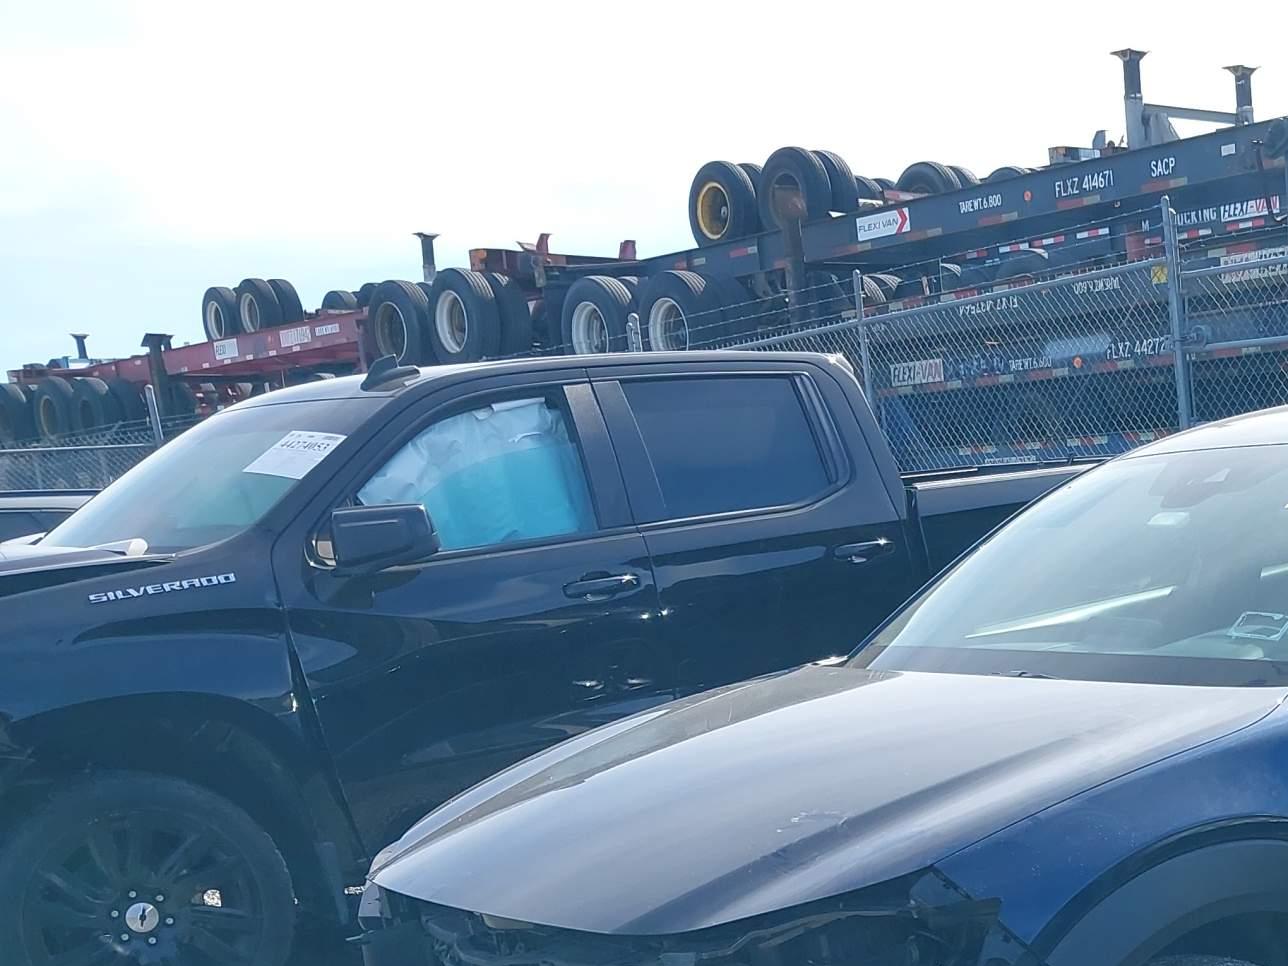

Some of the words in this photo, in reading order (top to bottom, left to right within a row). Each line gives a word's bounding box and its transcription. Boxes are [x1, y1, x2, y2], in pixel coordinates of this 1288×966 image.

[1150, 156, 1176, 178] SACP
[1055, 177, 1080, 198] FLXZ
[1082, 168, 1114, 191] 414671
[858, 219, 881, 233] FLEXI
[881, 216, 899, 230] VAN
[88, 573, 237, 604] SILVERADO
